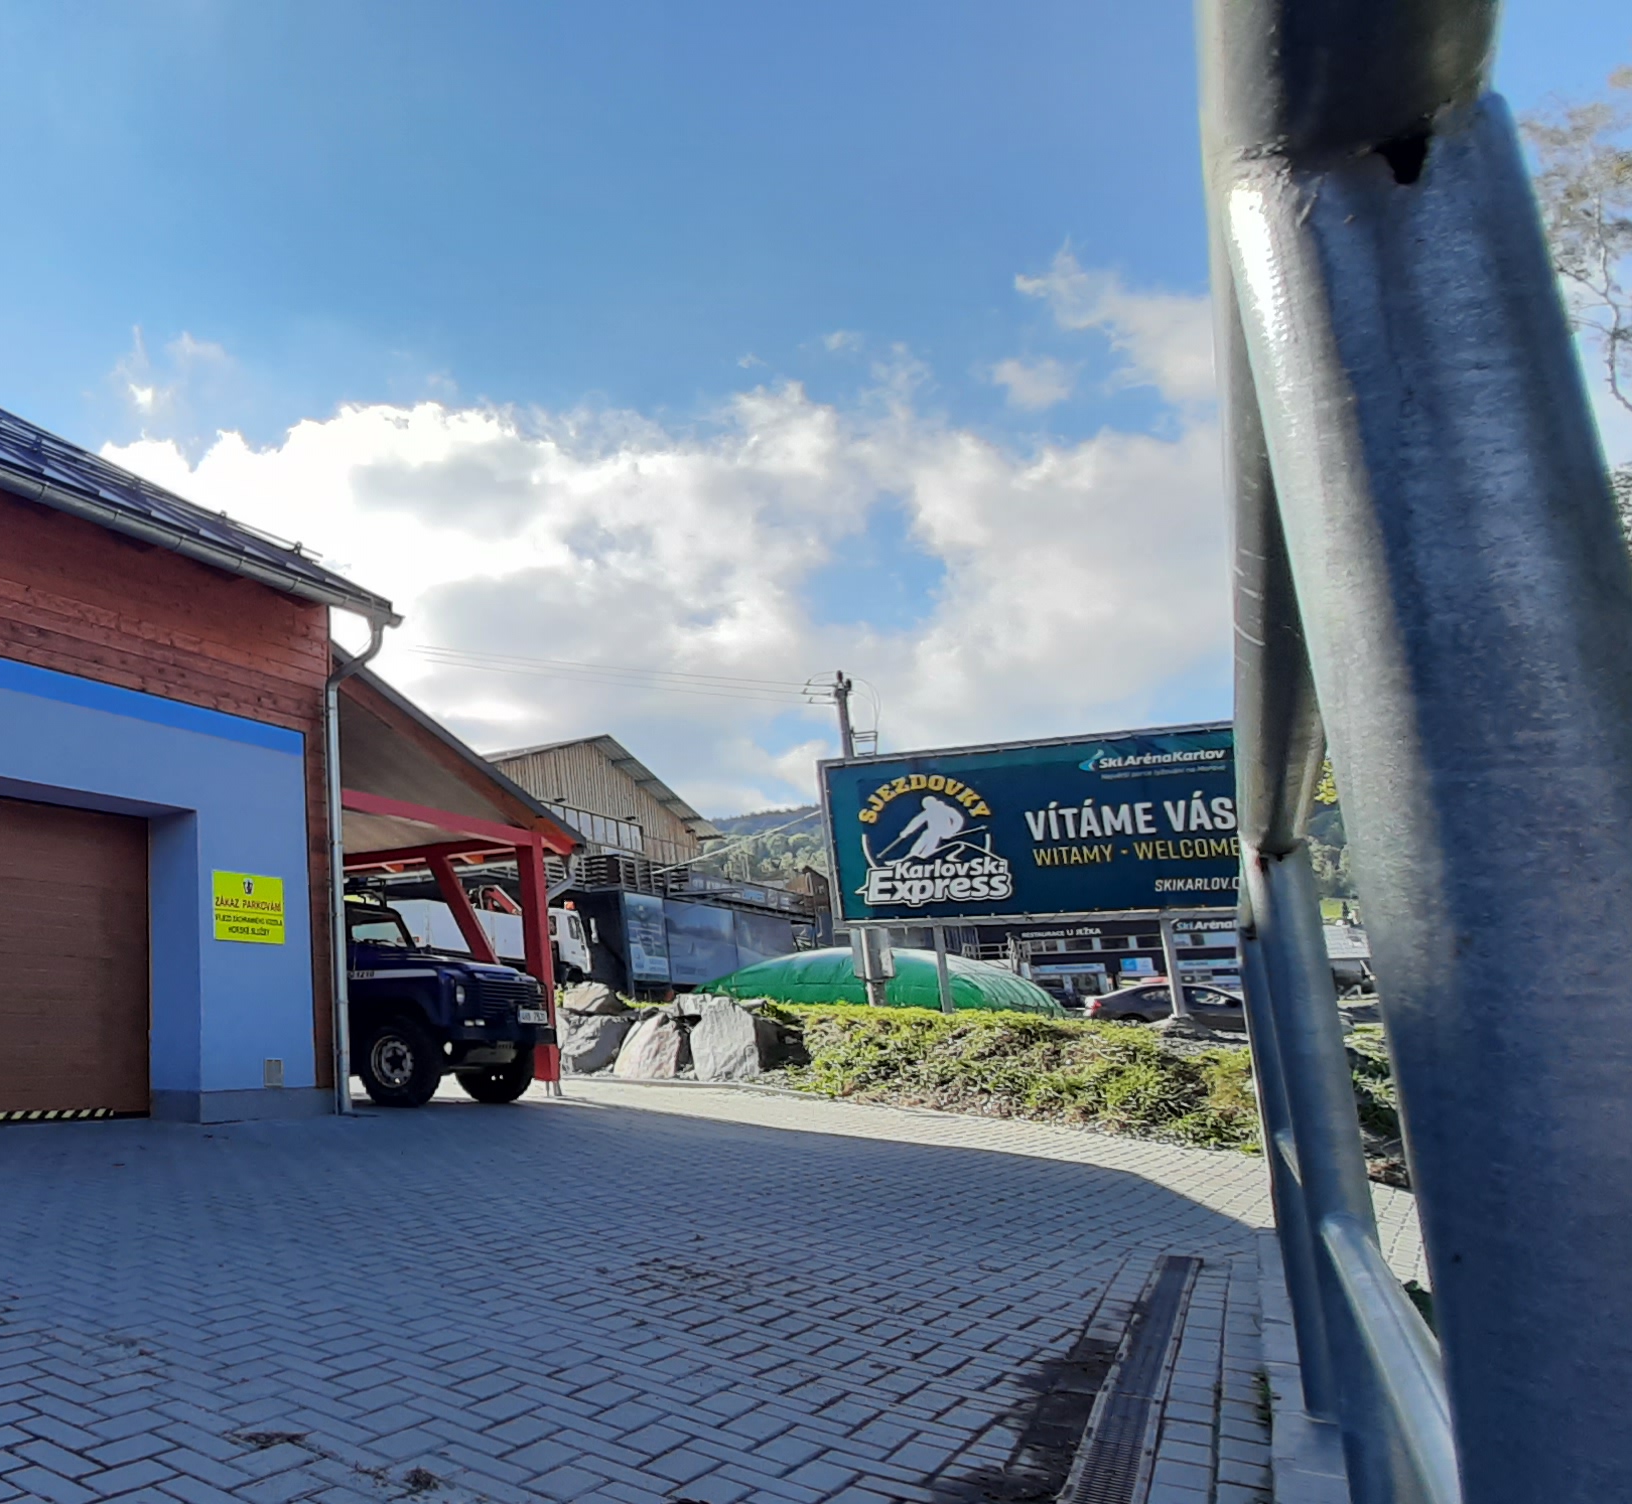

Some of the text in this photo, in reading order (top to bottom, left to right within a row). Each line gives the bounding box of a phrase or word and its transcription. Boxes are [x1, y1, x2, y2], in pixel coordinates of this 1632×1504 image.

[858, 773, 992, 824] SJEZDOVKY
[1024, 790, 1237, 842] VÍTÁME VÁS
[1032, 844, 1113, 867] WITAMY
[1132, 837, 1241, 861] WELCOME
[215, 895, 240, 908] ZÁKAZ
[868, 869, 1010, 905] Express
